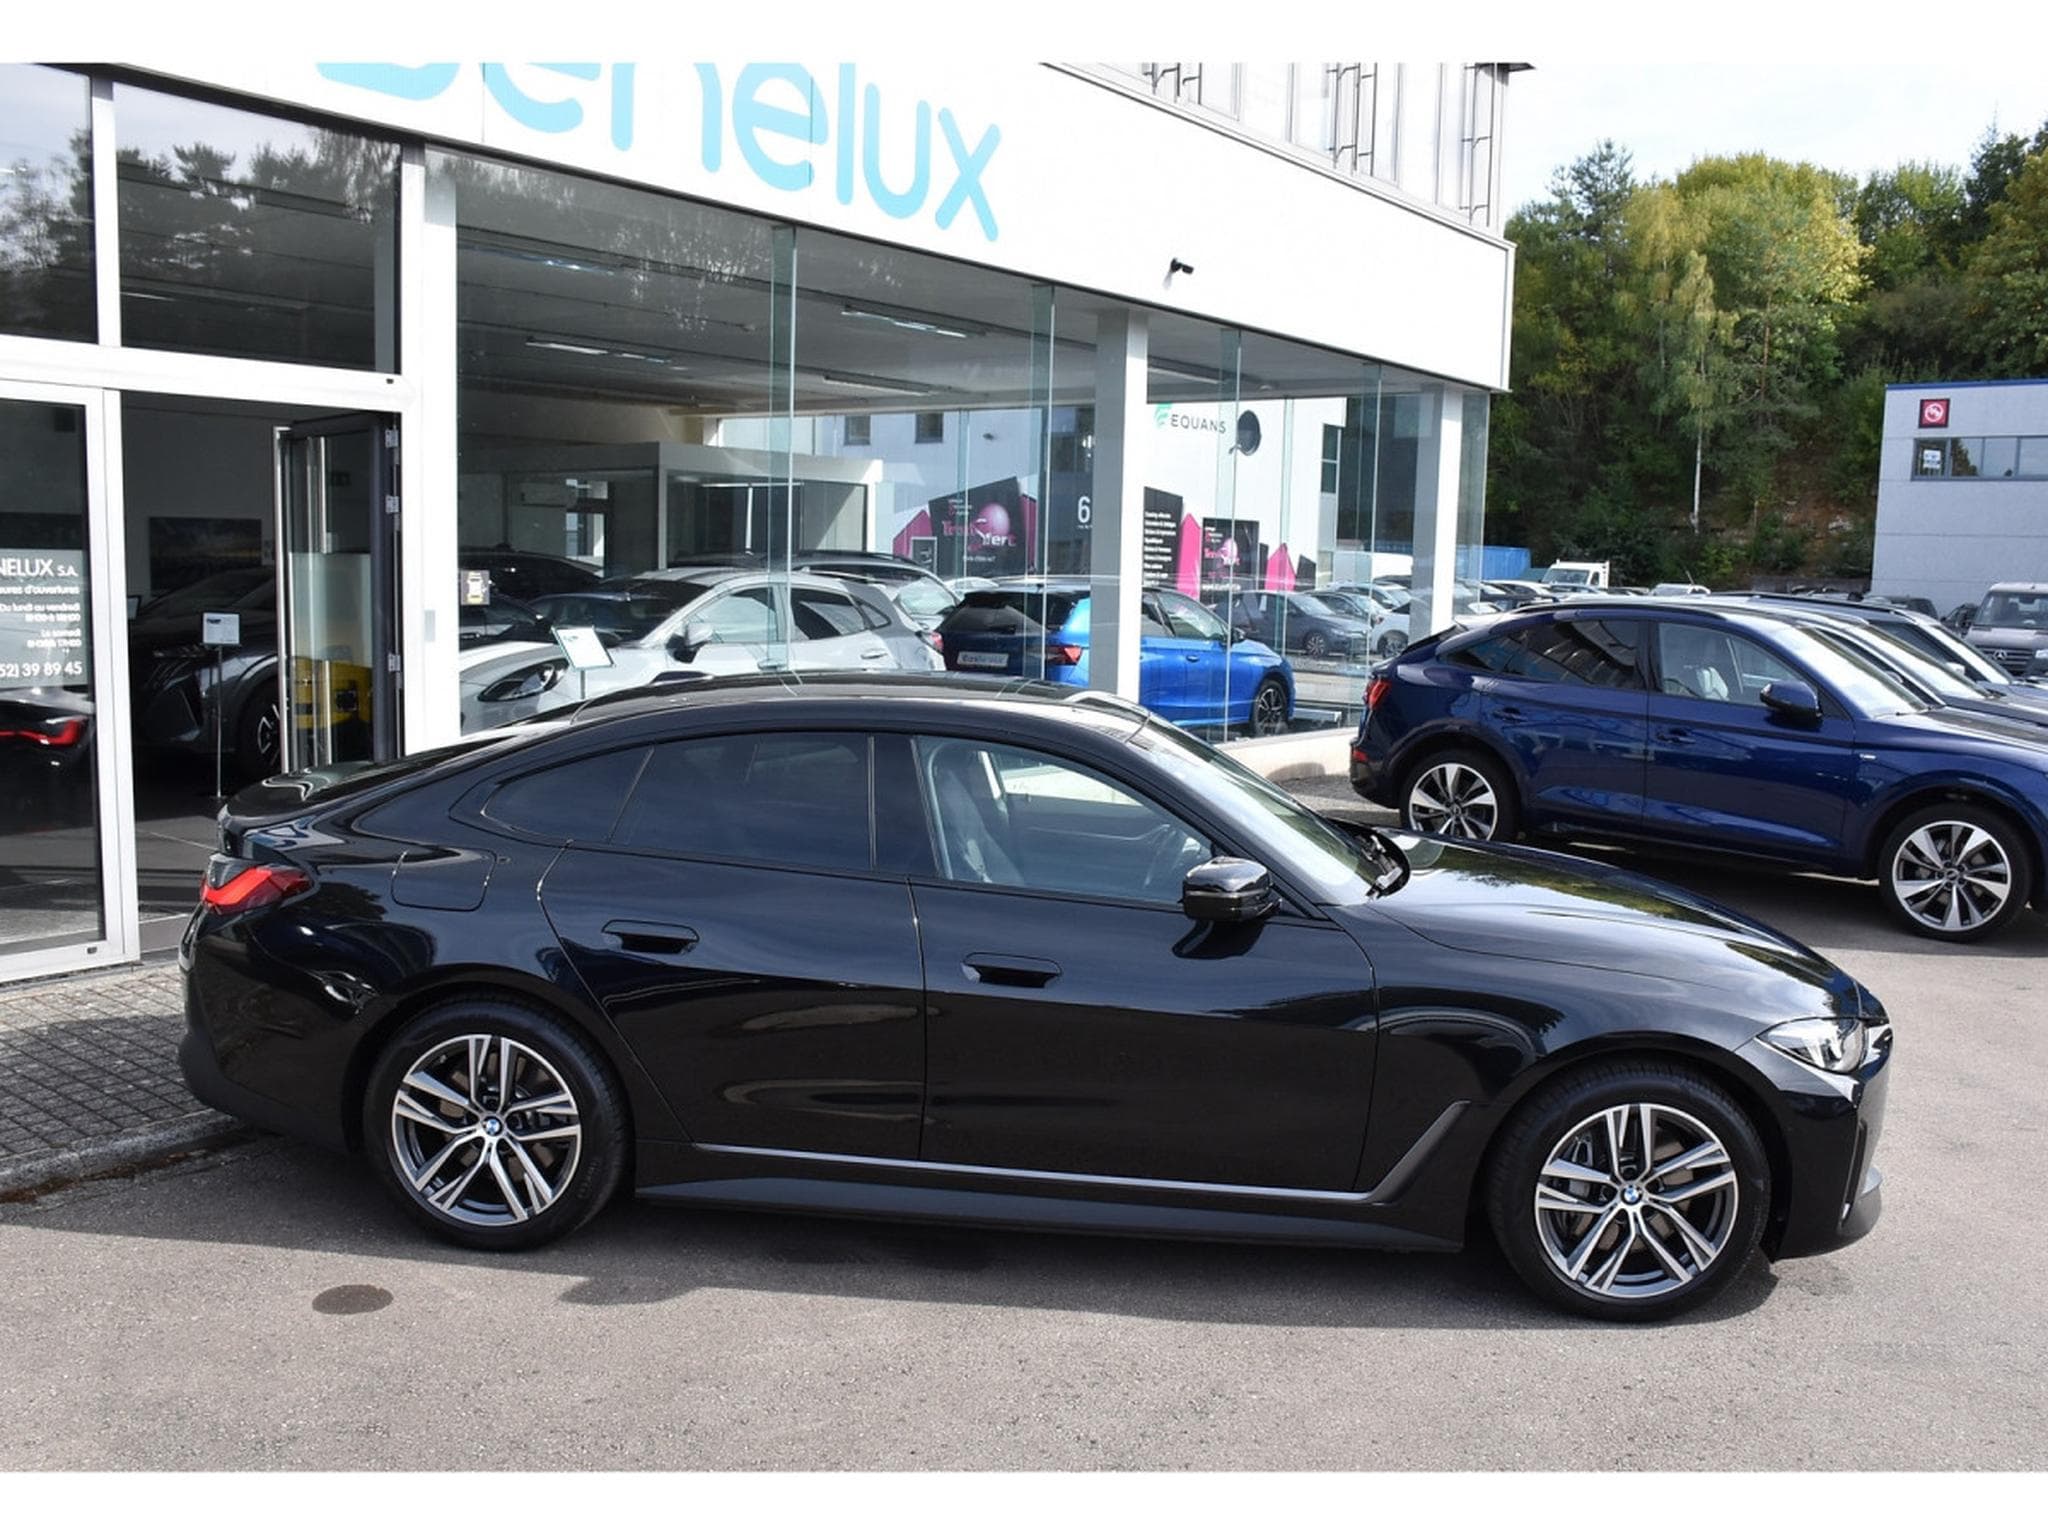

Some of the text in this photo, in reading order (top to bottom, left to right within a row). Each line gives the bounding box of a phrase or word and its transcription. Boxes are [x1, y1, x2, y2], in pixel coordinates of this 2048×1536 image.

[1170, 414, 1227, 434] EQUANS
[22, 661, 40, 677] 39
[44, 660, 62, 676] 89
[64, 659, 82, 675] 45
